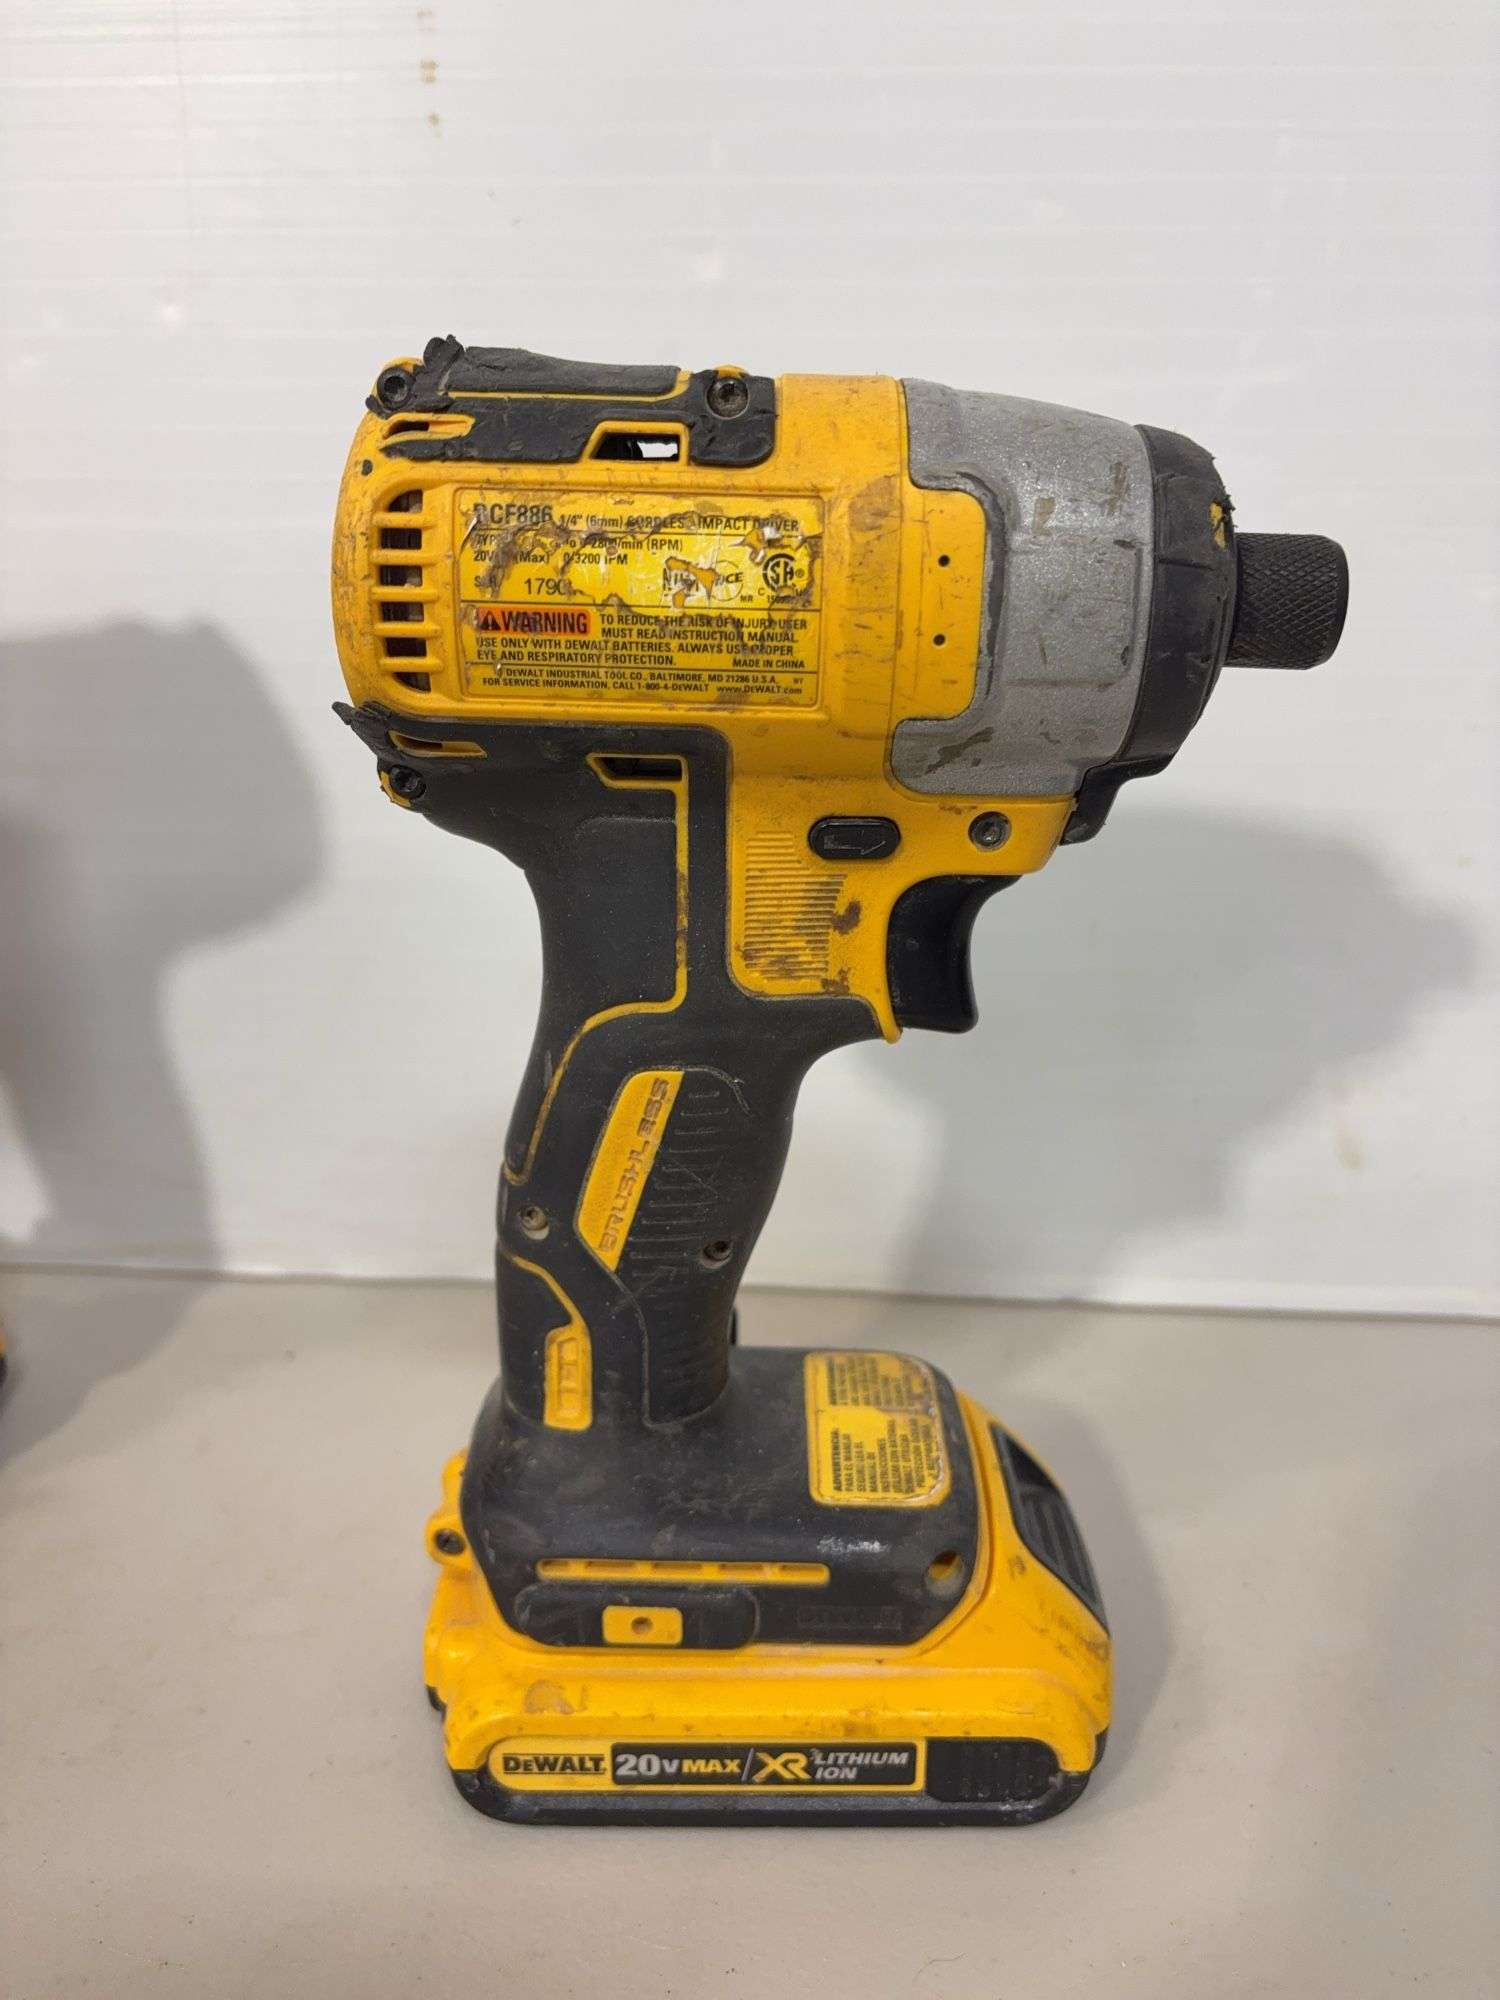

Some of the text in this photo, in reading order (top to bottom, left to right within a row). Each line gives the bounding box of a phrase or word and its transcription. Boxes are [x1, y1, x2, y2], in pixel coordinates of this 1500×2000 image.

[699, 518, 748, 531] IMPACT
[646, 538, 683, 552] (RPM)
[514, 551, 551, 565] (Max)
[501, 610, 588, 635] WARNING
[601, 613, 615, 625] TO
[617, 614, 661, 627] REDUCE
[663, 615, 684, 628] THE
[687, 616, 713, 628] RISK
[715, 616, 731, 629] OF
[778, 618, 807, 631] USER
[601, 627, 633, 639] MUST
[636, 628, 667, 640] READ
[670, 629, 745, 642] INSTRUCTION
[477, 636, 497, 648] USE
[500, 637, 529, 649] ONLY
[532, 638, 562, 650] WITH
[564, 639, 609, 651] DEWALT
[677, 642, 723, 655] ALWAYS
[726, 643, 749, 656] USE
[476, 649, 677, 667] EYE AND RESPIRATORY PROTECTION.
[732, 657, 805, 670] MADE IN CHINA
[545, 668, 601, 680] INDUSTRIAL
[604, 669, 626, 681] TOOL
[707, 673, 723, 684] MD
[482, 677, 500, 687] FOR
[502, 678, 541, 688] SERVICE
[612, 682, 634, 691] CALL
[682, 1758, 741, 1774] MAX
[752, 1751, 811, 1783] XR
[813, 1752, 909, 1765] LITHIUM
[814, 1766, 858, 1780] ION
